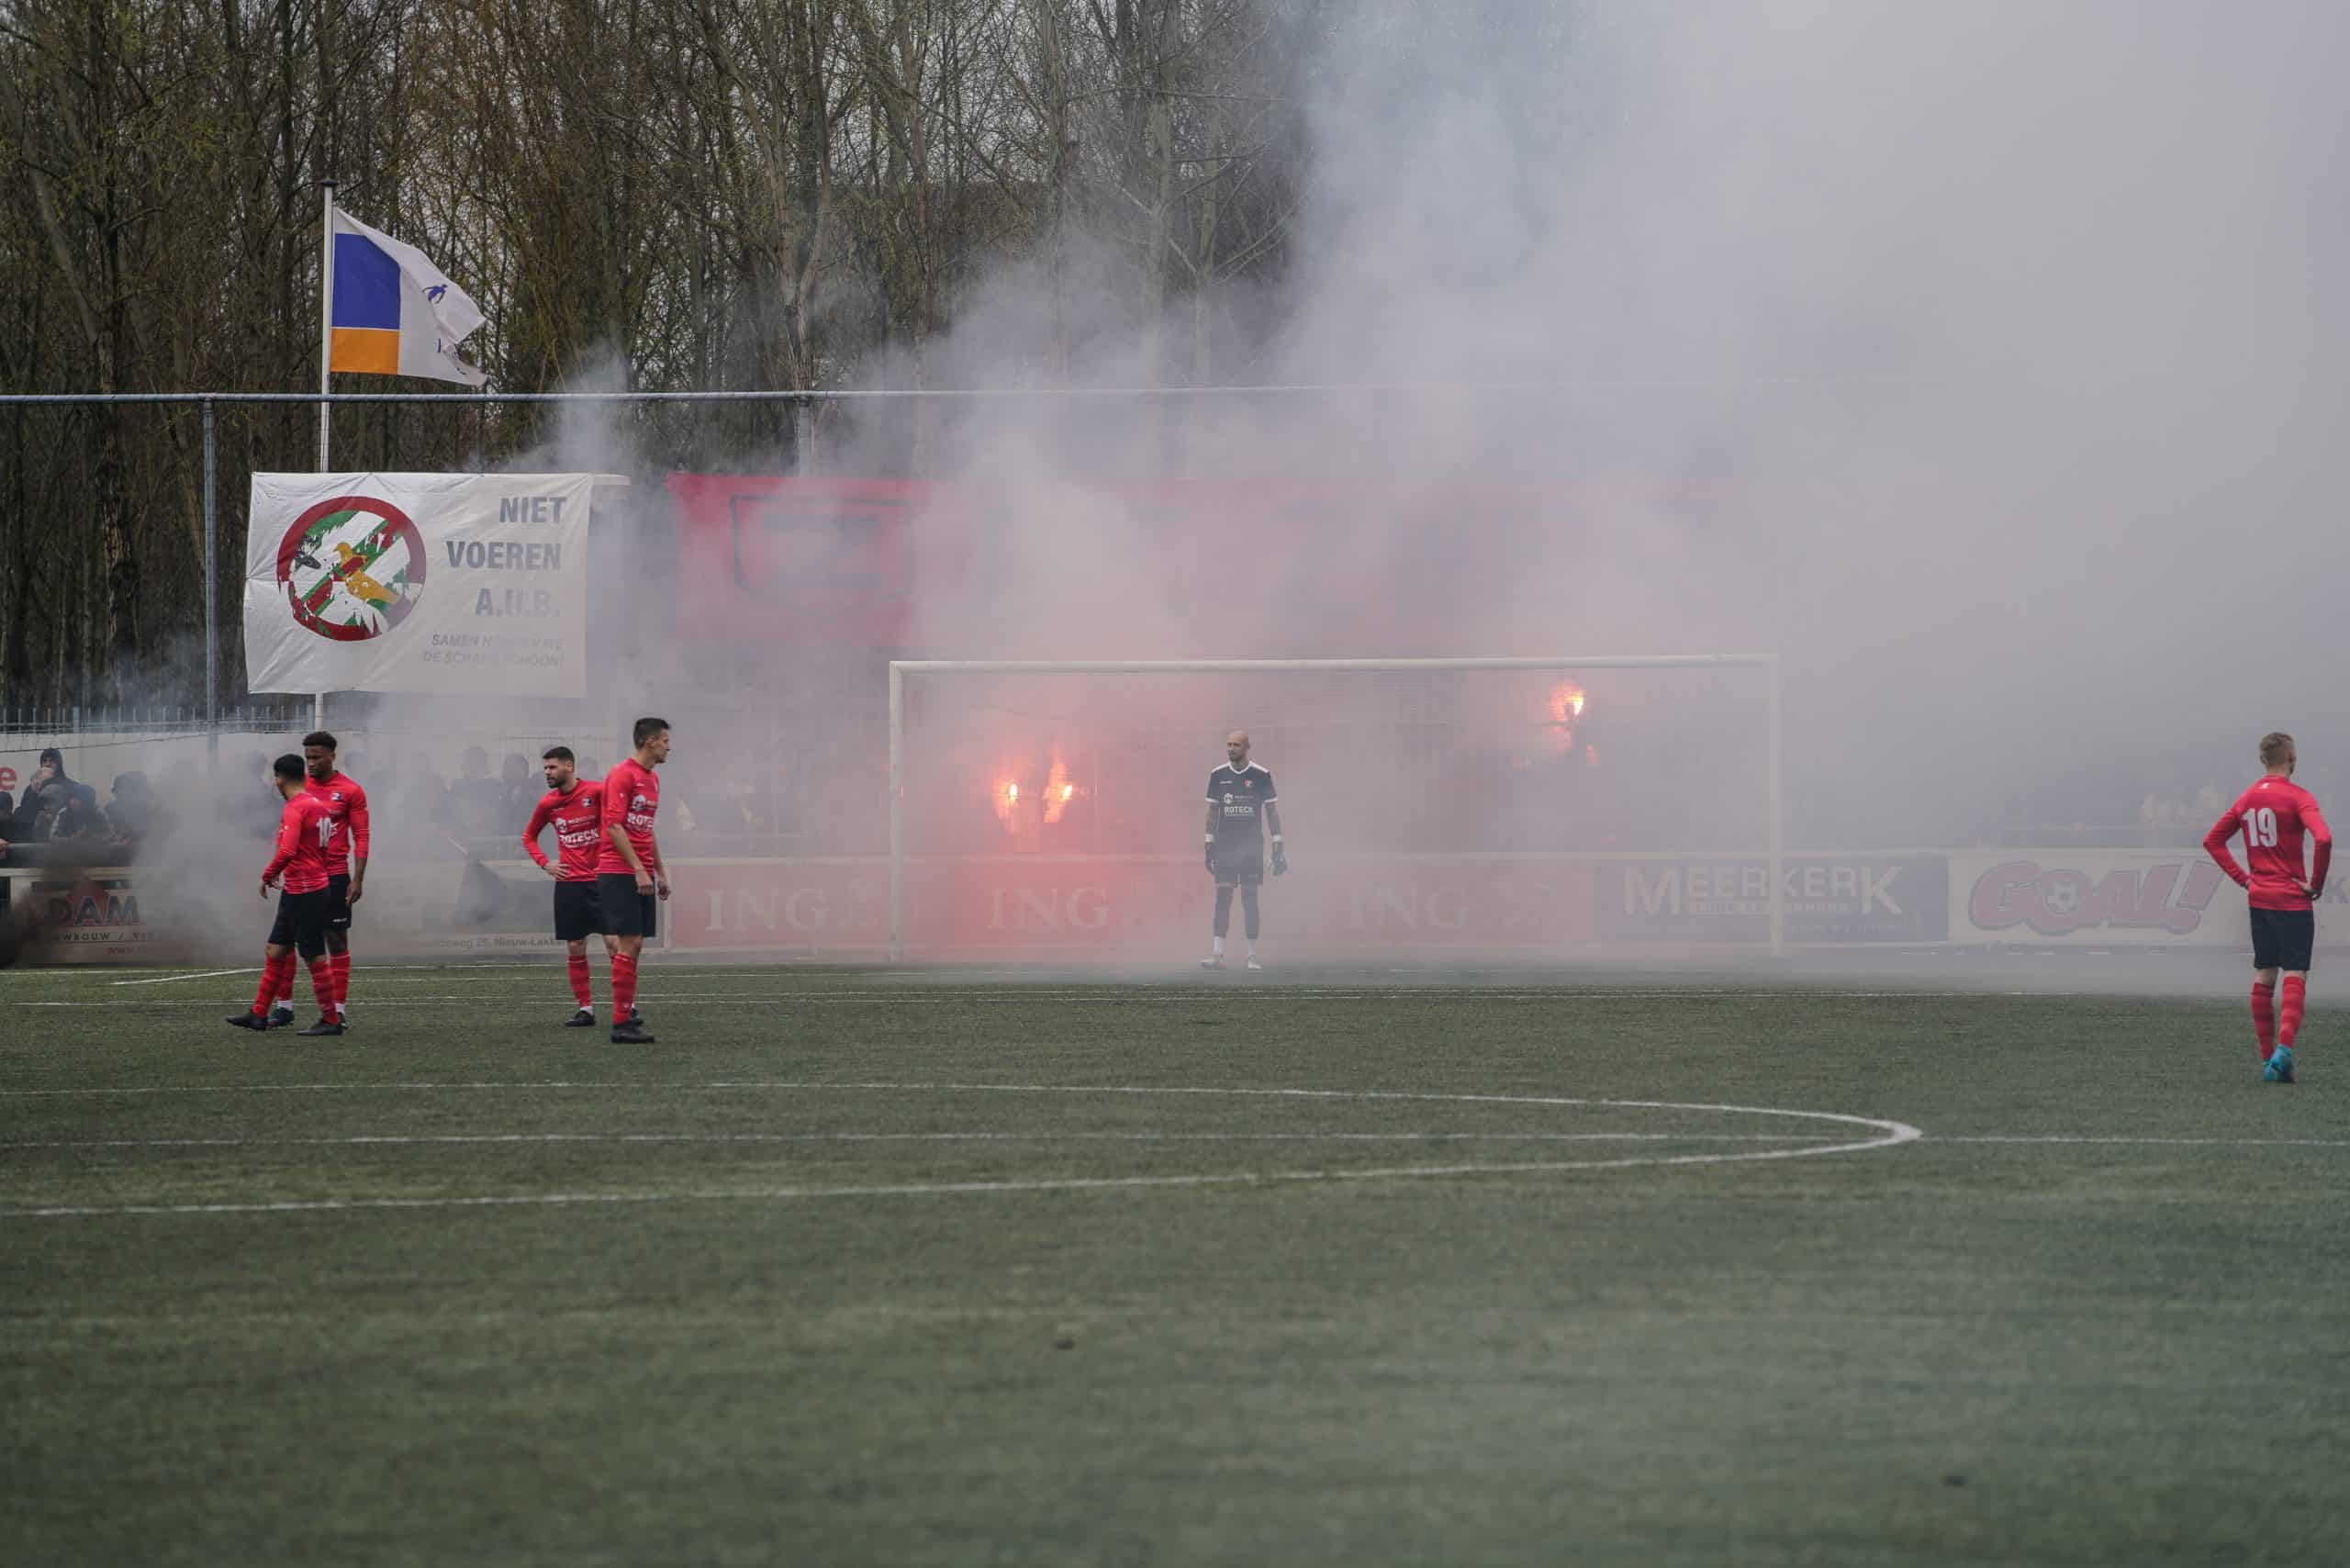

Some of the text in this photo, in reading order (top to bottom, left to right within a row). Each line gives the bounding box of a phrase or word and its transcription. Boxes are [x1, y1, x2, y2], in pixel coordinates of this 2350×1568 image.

[499, 497, 566, 523] NIET
[446, 541, 562, 571] VOEREN
[431, 633, 480, 647] SAMEN
[316, 817, 331, 846] 10
[2243, 808, 2277, 846] 19
[1623, 866, 1903, 916] MEERKERK
[704, 888, 829, 932] ING
[987, 887, 1109, 933] ING
